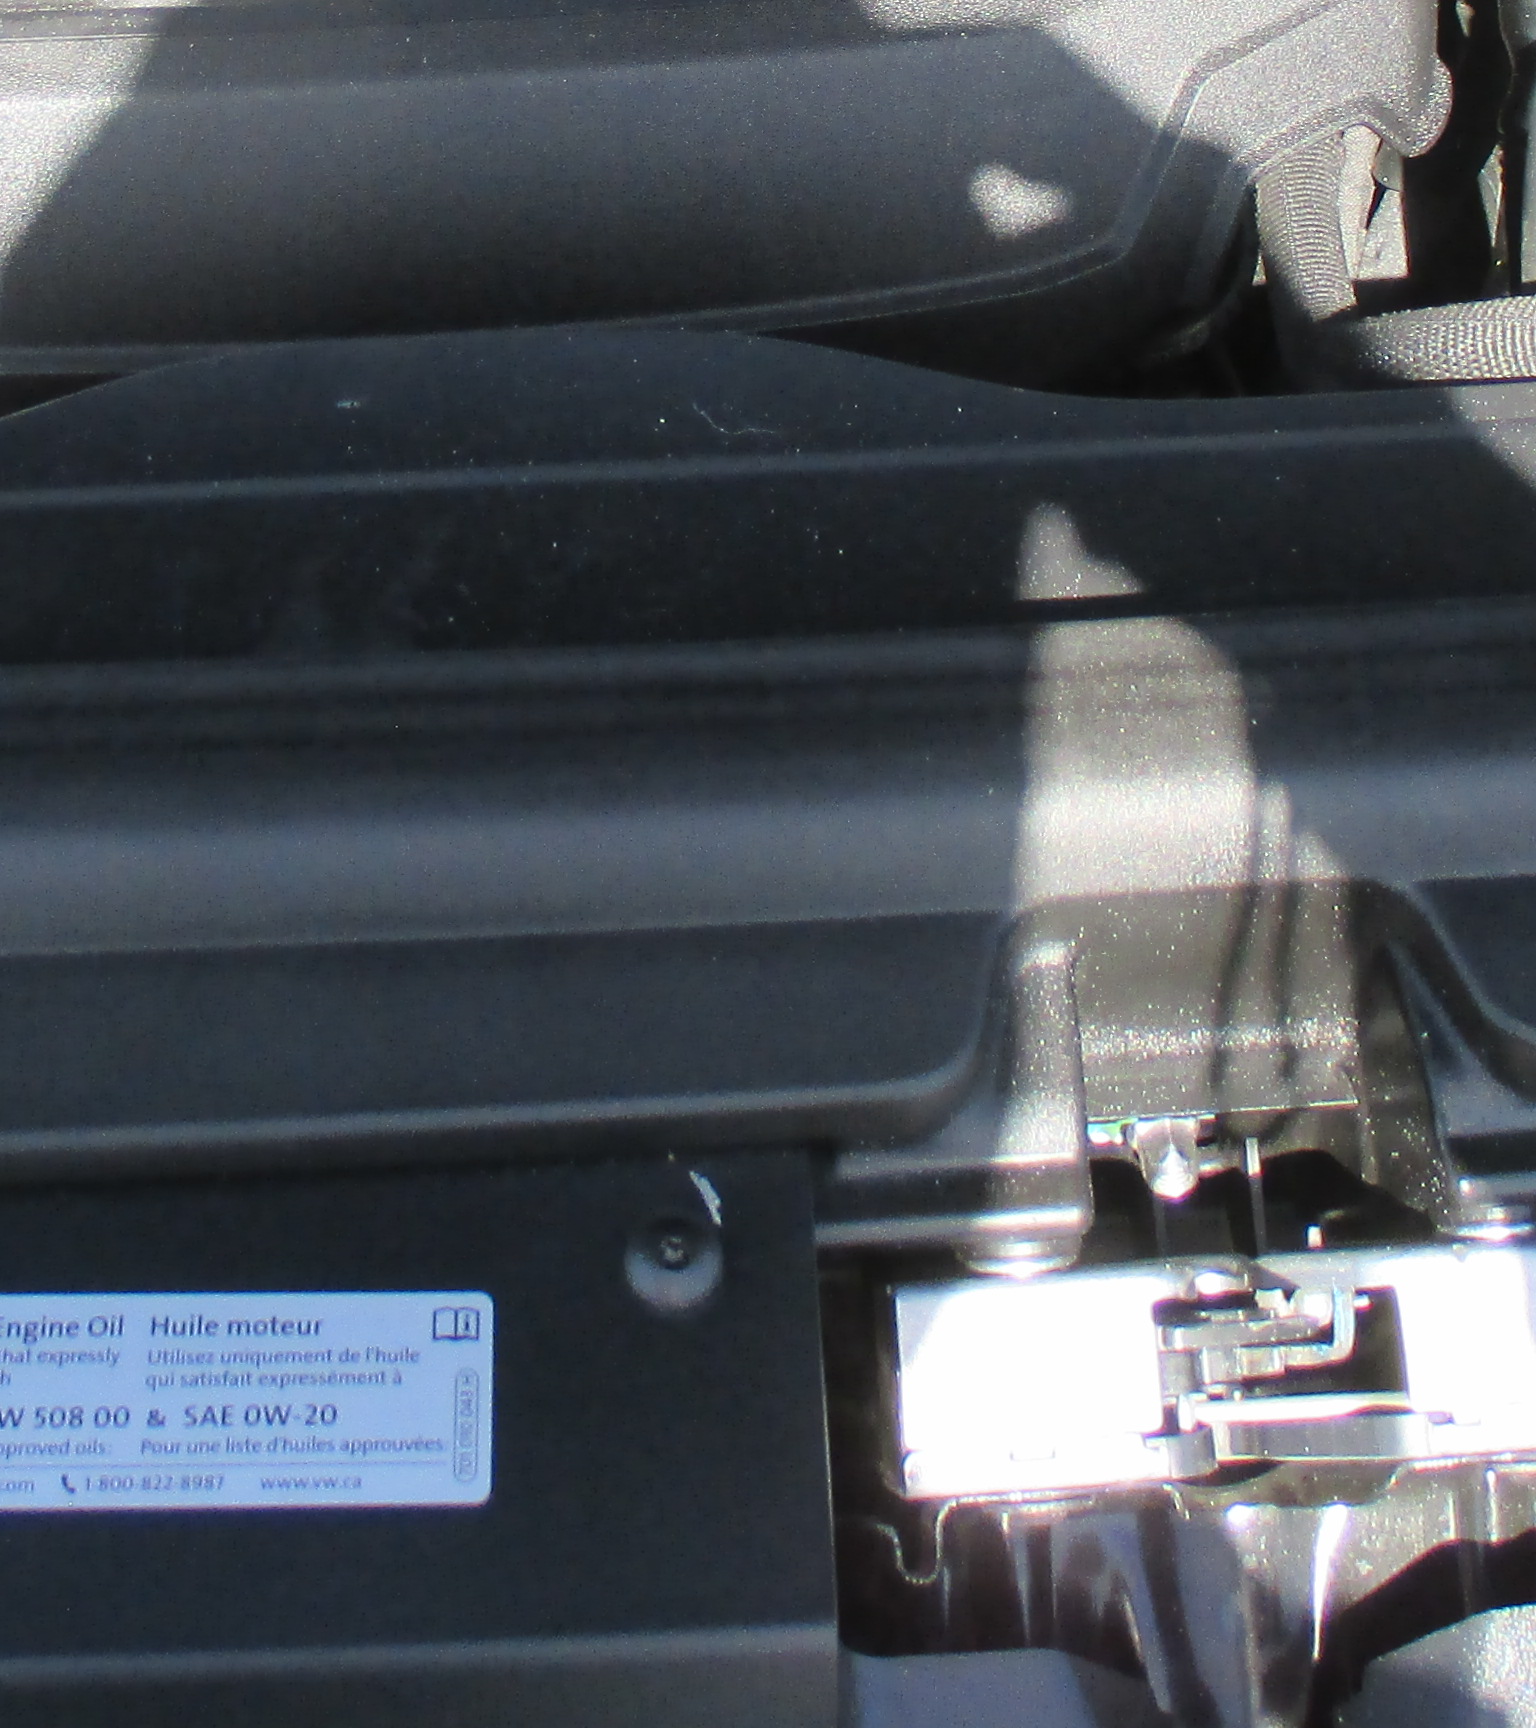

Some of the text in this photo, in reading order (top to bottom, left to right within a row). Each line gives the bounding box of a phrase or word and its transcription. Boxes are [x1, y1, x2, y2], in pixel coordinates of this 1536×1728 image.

[87, 1314, 125, 1338] Oil
[150, 1315, 324, 1338] Huile moteur
[37, 1346, 120, 1367] expressly
[147, 1346, 421, 1369] Utilisez uniquement de l'huile
[145, 1372, 175, 1390] qui
[180, 1371, 252, 1387] satisfait
[391, 1369, 403, 1385] à
[33, 1406, 84, 1428] 508
[93, 1406, 131, 1428] 00
[147, 1409, 166, 1427] &
[184, 1405, 235, 1427] SAE
[243, 1403, 339, 1427] 0W-20
[141, 1436, 335, 1455] Pour une liste d'huiles
